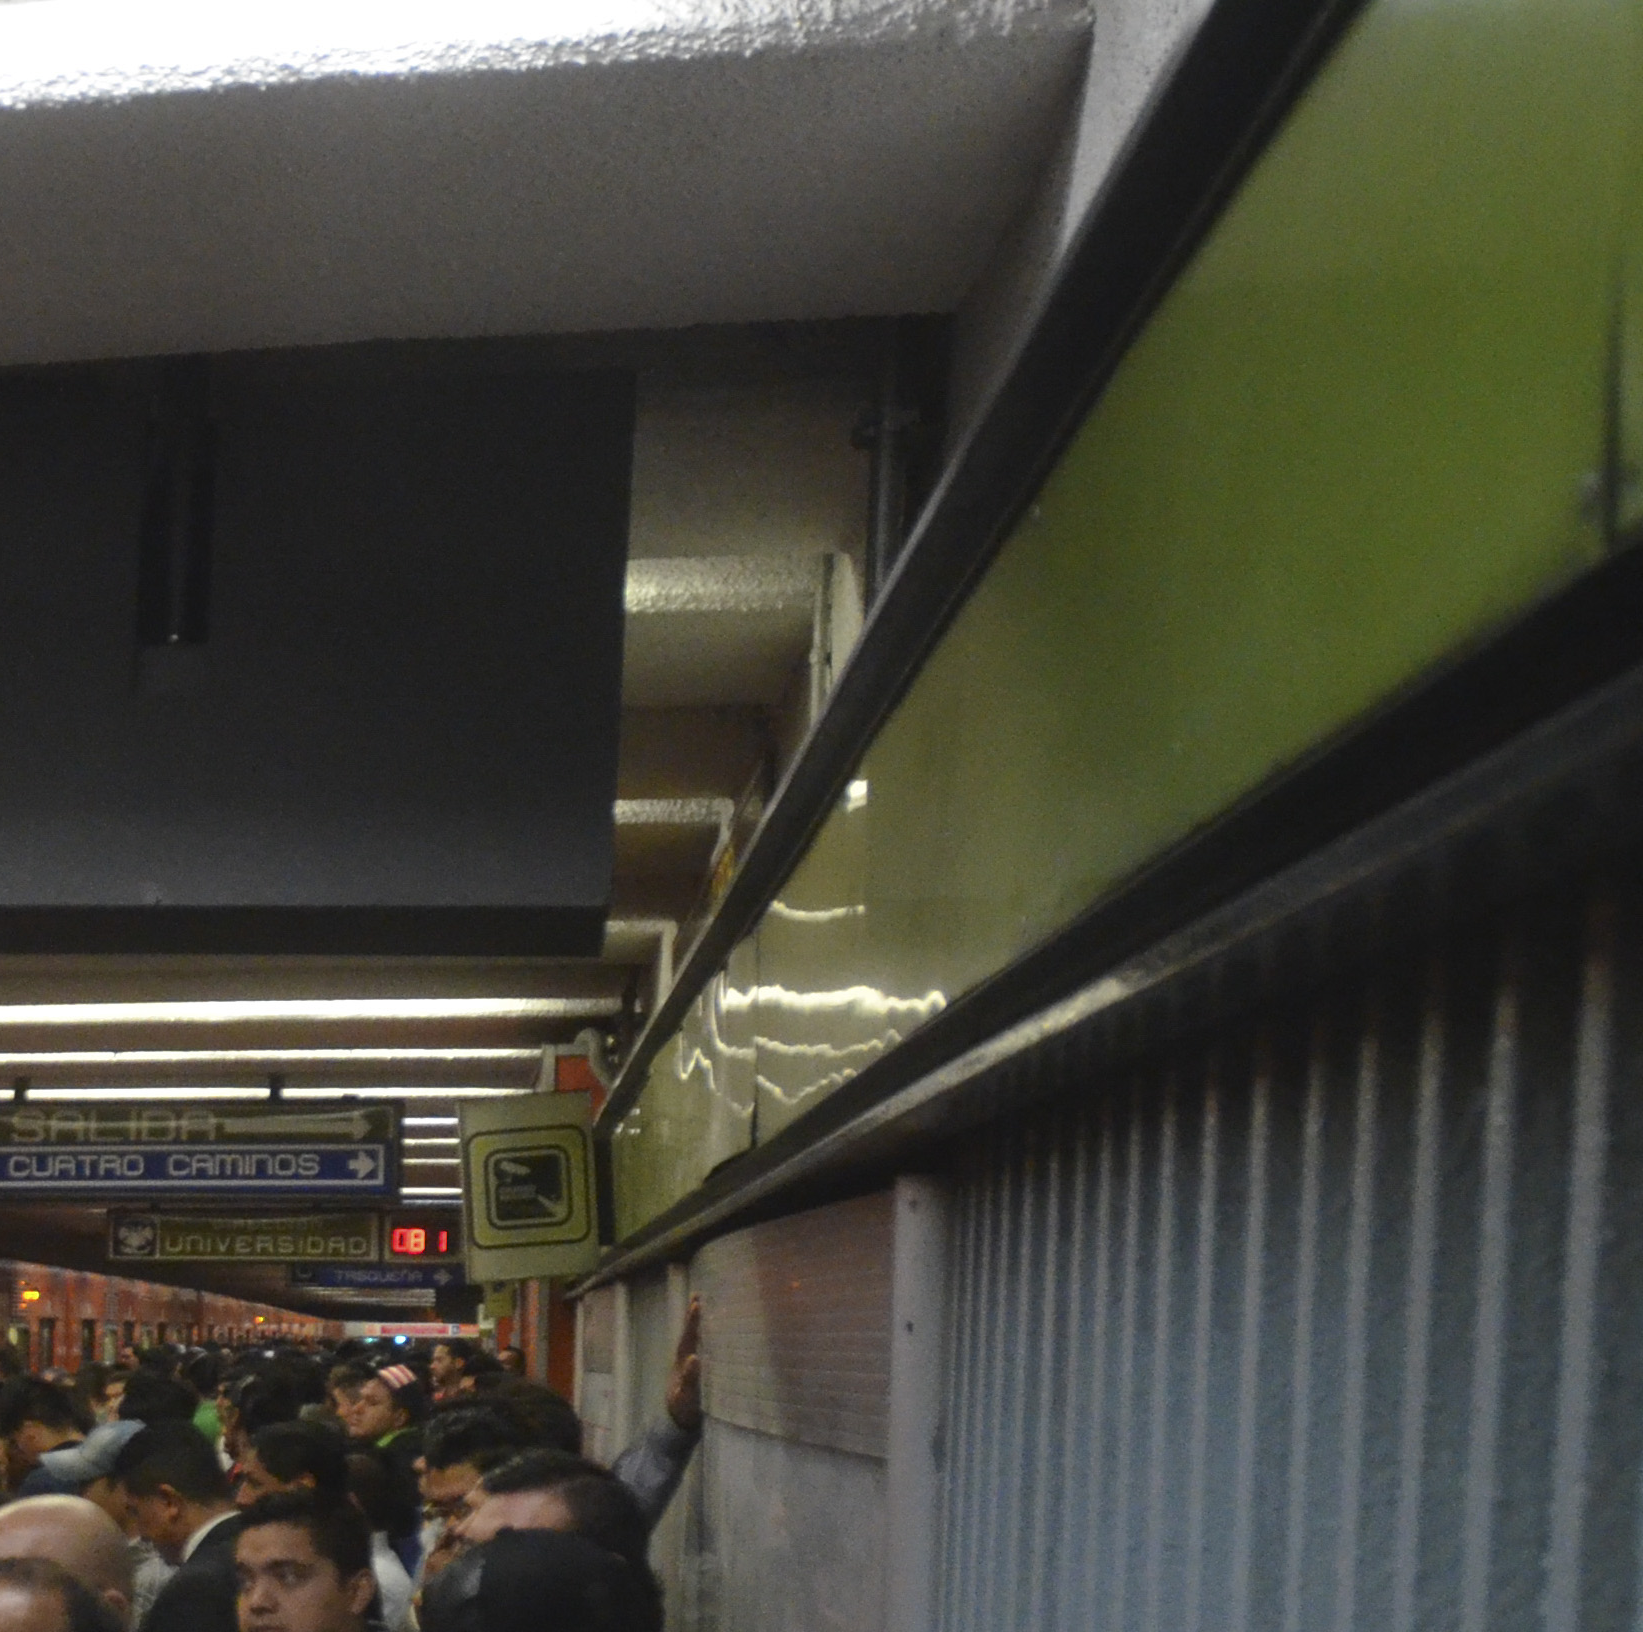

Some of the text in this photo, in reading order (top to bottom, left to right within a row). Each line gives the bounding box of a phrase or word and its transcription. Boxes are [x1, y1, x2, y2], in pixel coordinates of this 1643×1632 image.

[12, 1109, 216, 1142] SALIDA
[8, 1153, 321, 1178] CUATRO CAMINOS
[166, 1234, 367, 1255] UNIVERSIDAD
